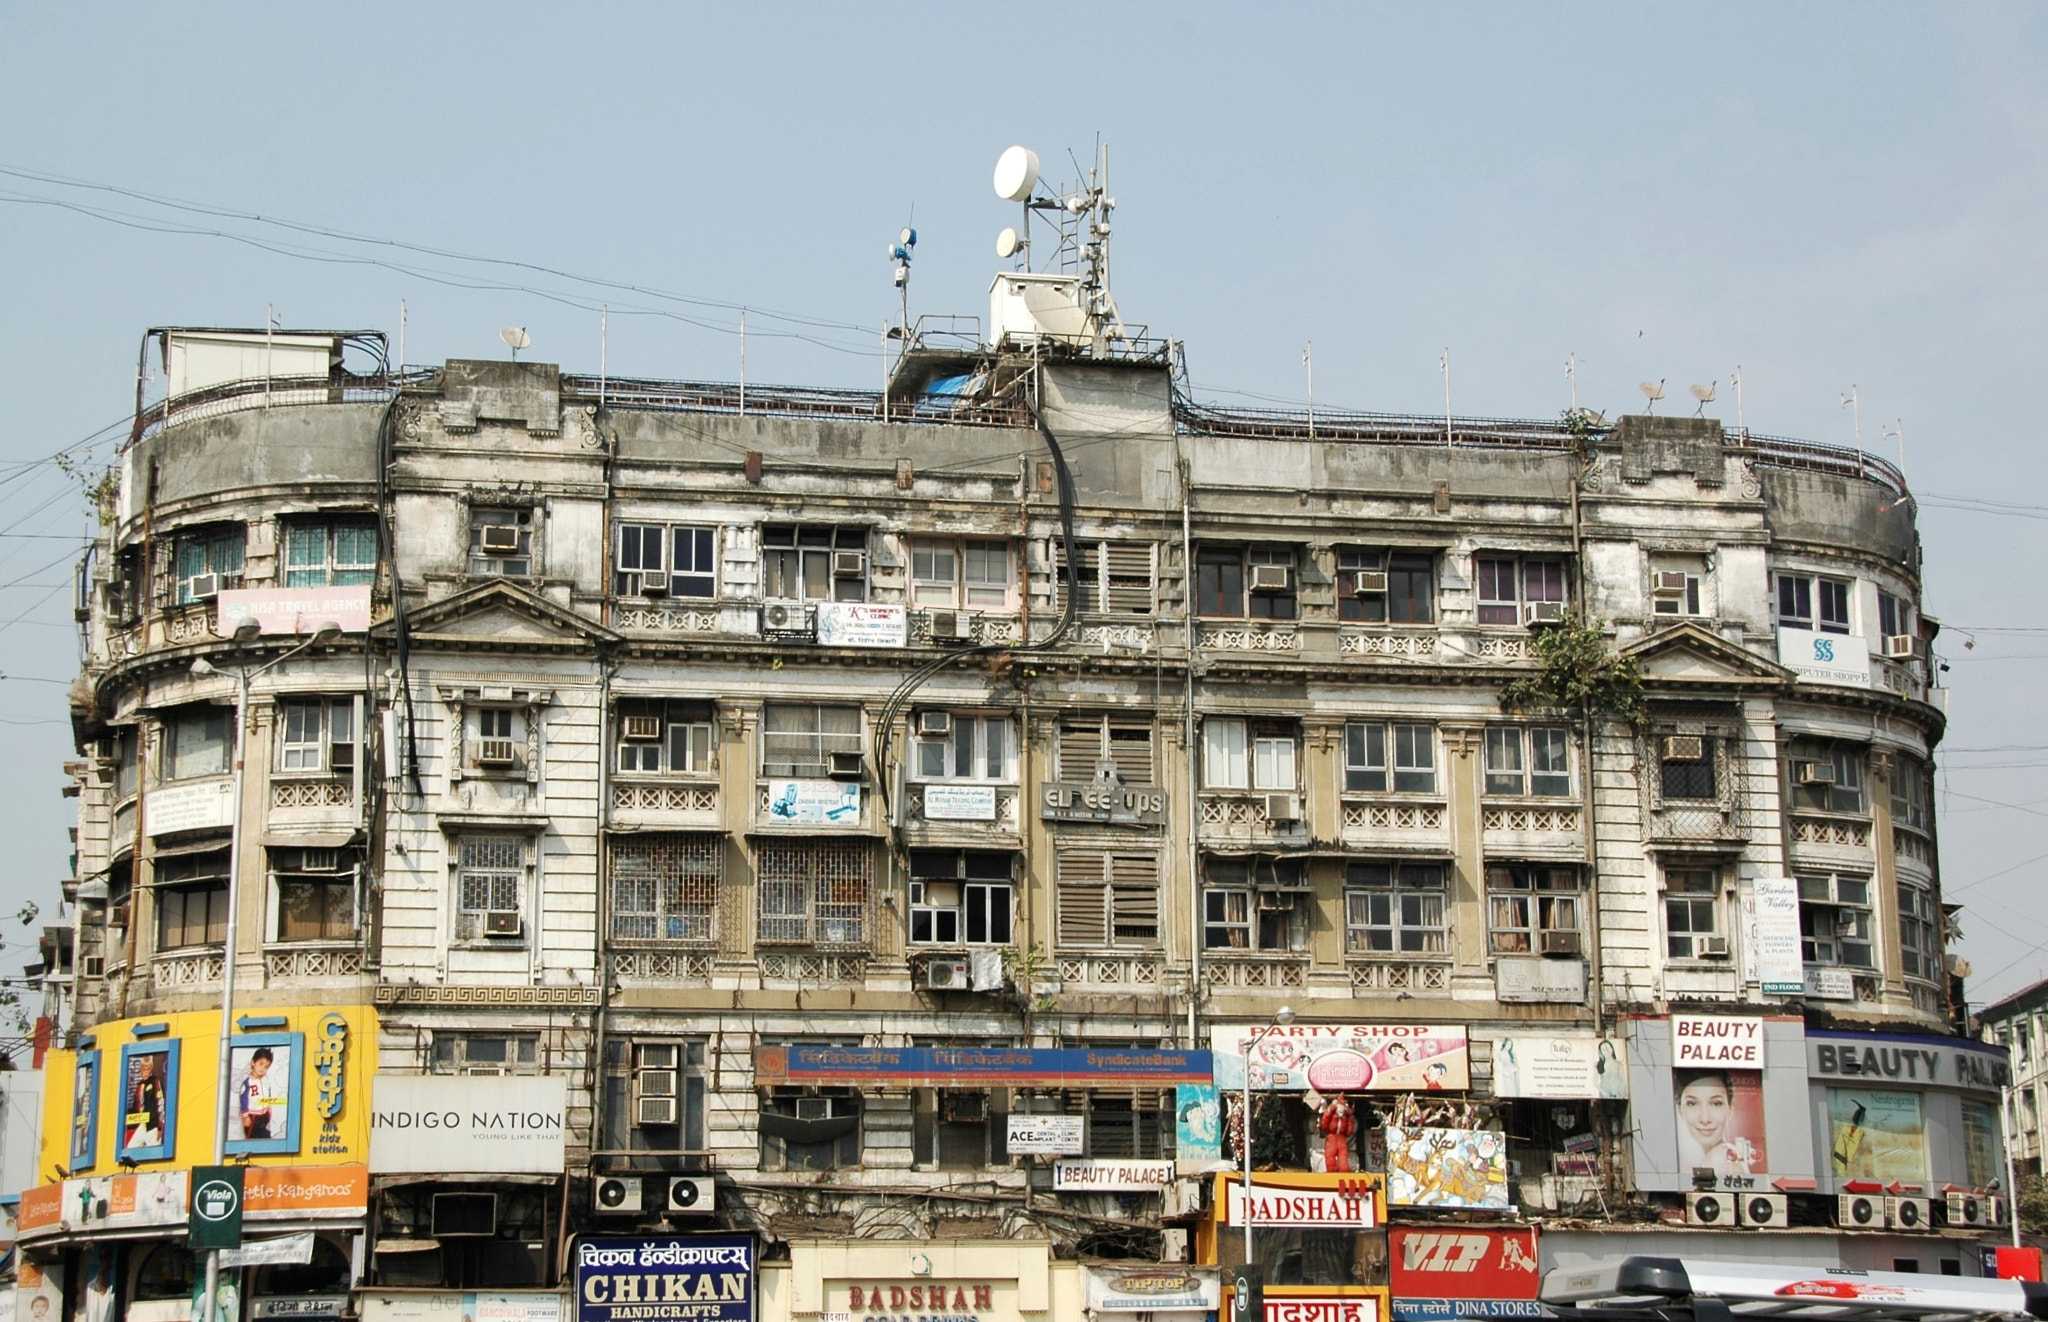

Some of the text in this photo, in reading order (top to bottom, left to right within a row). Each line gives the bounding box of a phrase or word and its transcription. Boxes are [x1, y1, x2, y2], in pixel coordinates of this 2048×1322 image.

[250, 599, 366, 614] NISA TRAVEL AGENCY
[1833, 671, 1869, 683] SHOPPE
[1756, 883, 1795, 896] Garden
[1763, 897, 1796, 911] Valley
[1763, 983, 1803, 991] 2ND FLOOR
[1250, 1026, 1429, 1037] PARTY SHOP
[1677, 1021, 1758, 1038] BEAUTY
[1553, 1043, 1572, 1054] Tulip
[1680, 1044, 1757, 1061] PALACE
[315, 1013, 346, 1119] Comfort
[1086, 1053, 1188, 1068] SyndicateBank
[1817, 1044, 1939, 1079] BEAUTY
[249, 1084, 259, 1097] R
[1870, 1092, 1916, 1106] Neutrogena
[322, 1123, 339, 1132] the
[371, 1111, 562, 1129] INDIGO NATION
[319, 1133, 341, 1144] kidz
[1009, 1131, 1034, 1142] ACE
[312, 1142, 348, 1154] station
[1064, 1166, 1165, 1184] BEAUTY PALACE
[207, 1189, 232, 1200] Viola
[243, 1183, 352, 1200] ittle Kangaroos
[1241, 1197, 1363, 1220] BADSHAH
[578, 1243, 636, 1267] चिकन
[1402, 1233, 1491, 1272] VIP
[584, 1273, 747, 1303] CHIKAN
[849, 1284, 992, 1311] BADSHAH
[610, 1305, 721, 1319] HANDICRAFTS
[1455, 1301, 1541, 1316] DINA STORES
